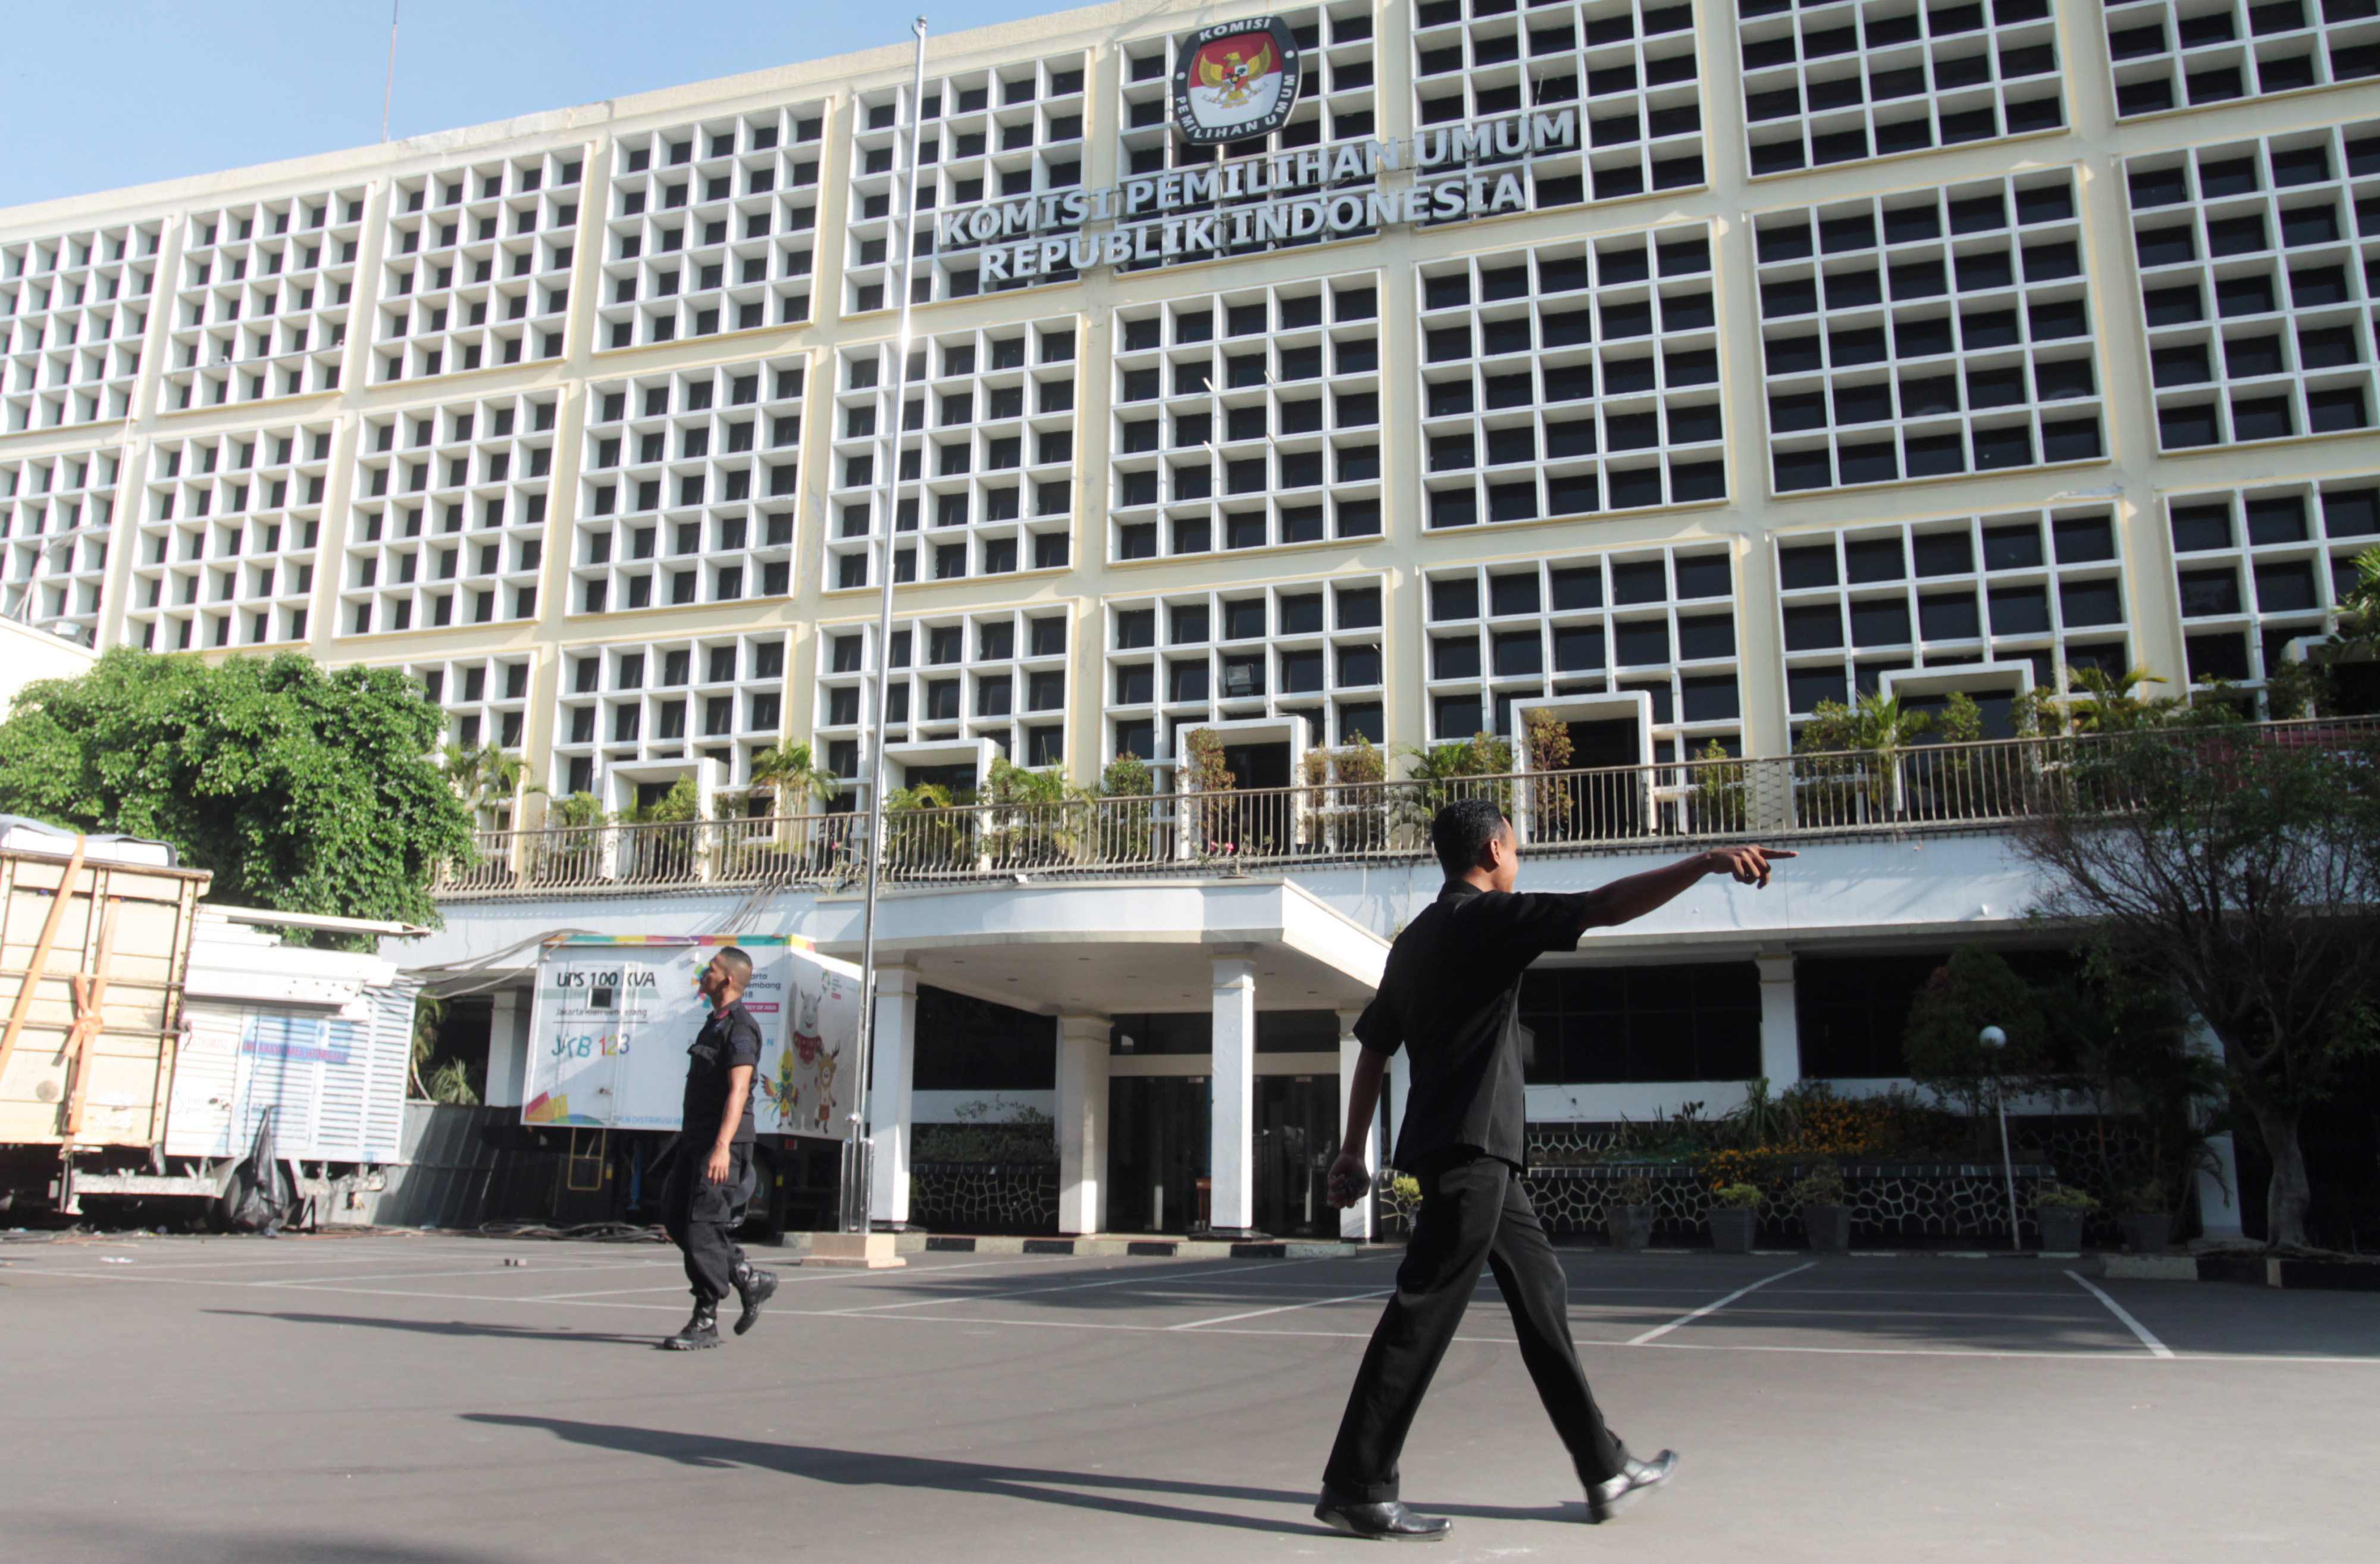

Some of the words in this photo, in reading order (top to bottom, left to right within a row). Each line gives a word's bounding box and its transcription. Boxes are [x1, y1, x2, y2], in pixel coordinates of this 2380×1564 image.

[1199, 18, 1271, 42] KOMISI
[1176, 96, 1258, 139] PEMILIHAN
[1264, 74, 1295, 125] UMUM
[940, 187, 1113, 246] KOMISI
[1126, 137, 1398, 214] PEMILIHAN
[1413, 110, 1574, 168] UMUM
[981, 215, 1216, 282] REPUBLIK
[1230, 173, 1526, 245] INDONESIA
[556, 972, 585, 988] UPS
[590, 972, 618, 987] 100
[748, 982, 781, 990] embang
[556, 1008, 583, 1016] Jakarta
[181, 1036, 228, 1049] STRIBUSI
[551, 1033, 592, 1059] JKB
[598, 1033, 631, 1057] 123
[632, 1116, 672, 1125] DISTRIBUSI
